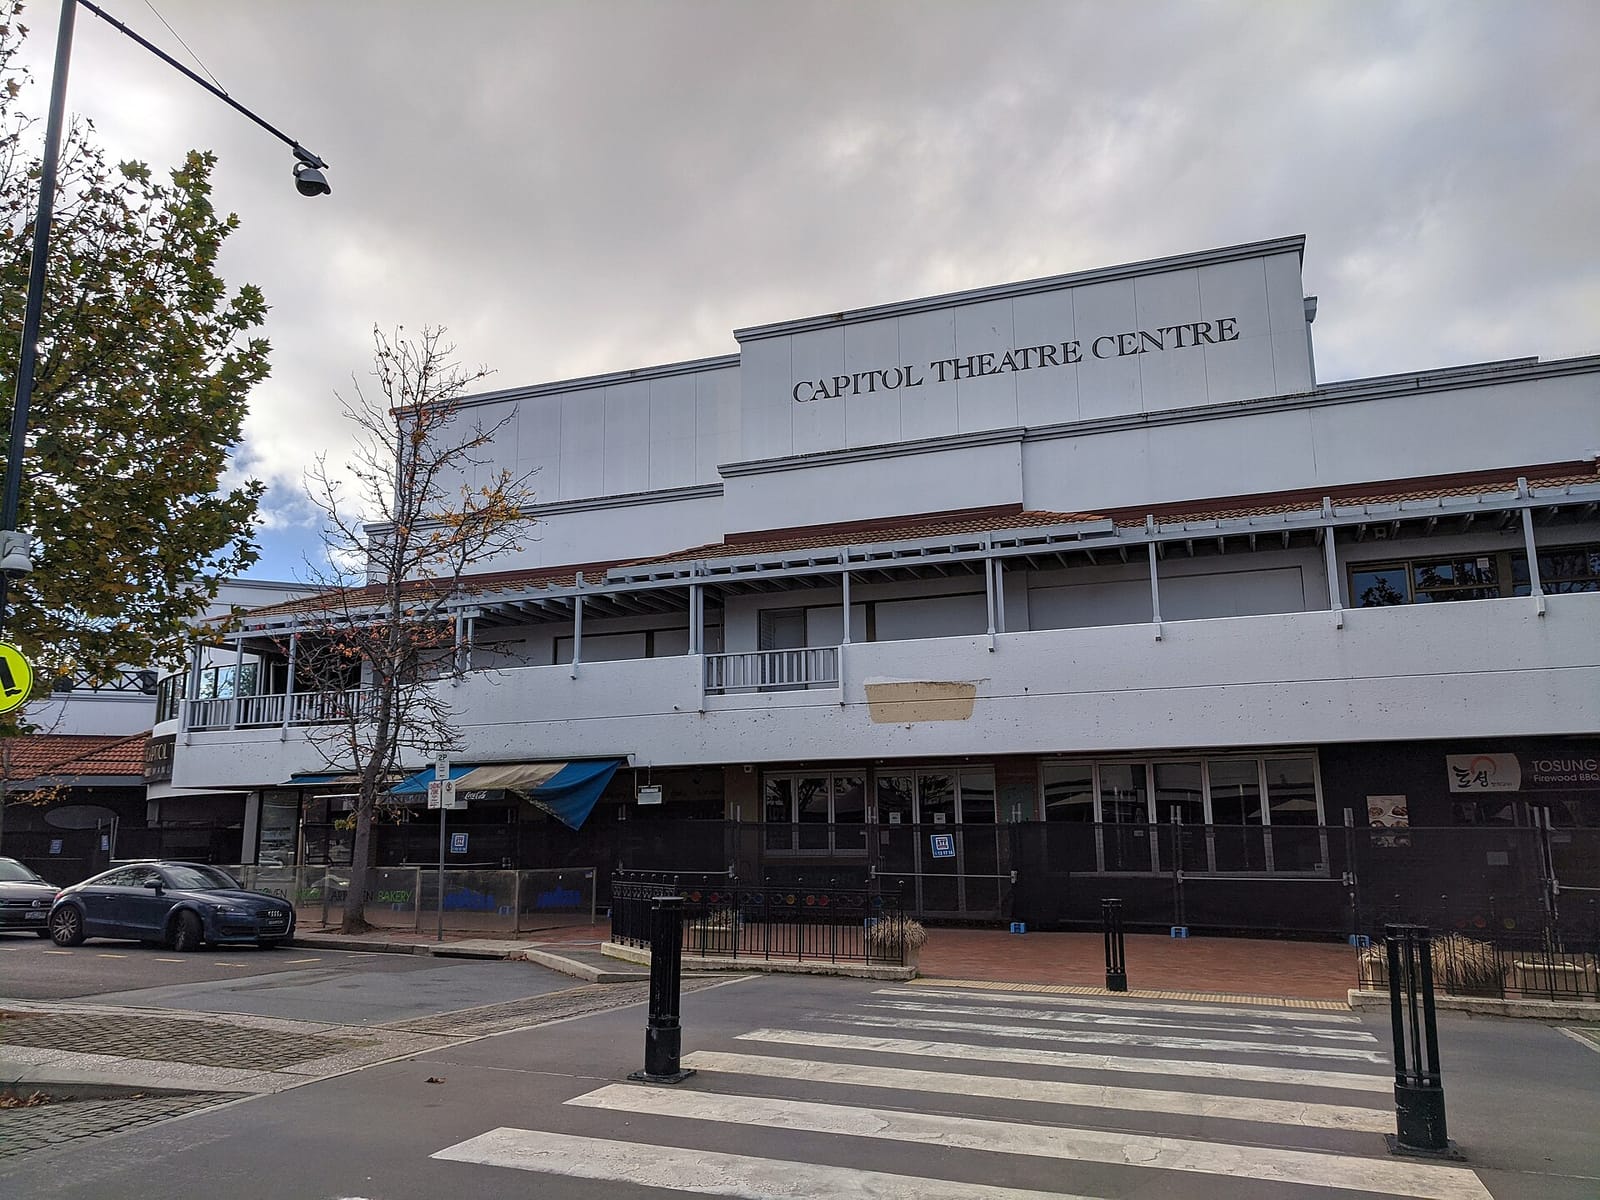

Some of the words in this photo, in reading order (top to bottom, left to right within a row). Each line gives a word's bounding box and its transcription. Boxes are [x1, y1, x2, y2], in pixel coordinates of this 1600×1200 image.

[792, 364, 924, 403] CAPITOL
[930, 340, 1082, 383] THEATRE
[1091, 317, 1240, 359] CENTRE
[1532, 759, 1597, 772] TOSUNG
[1533, 774, 1577, 783] Firewood
[1579, 773, 1600, 782] BBQ
[377, 889, 413, 903] BAKERY
